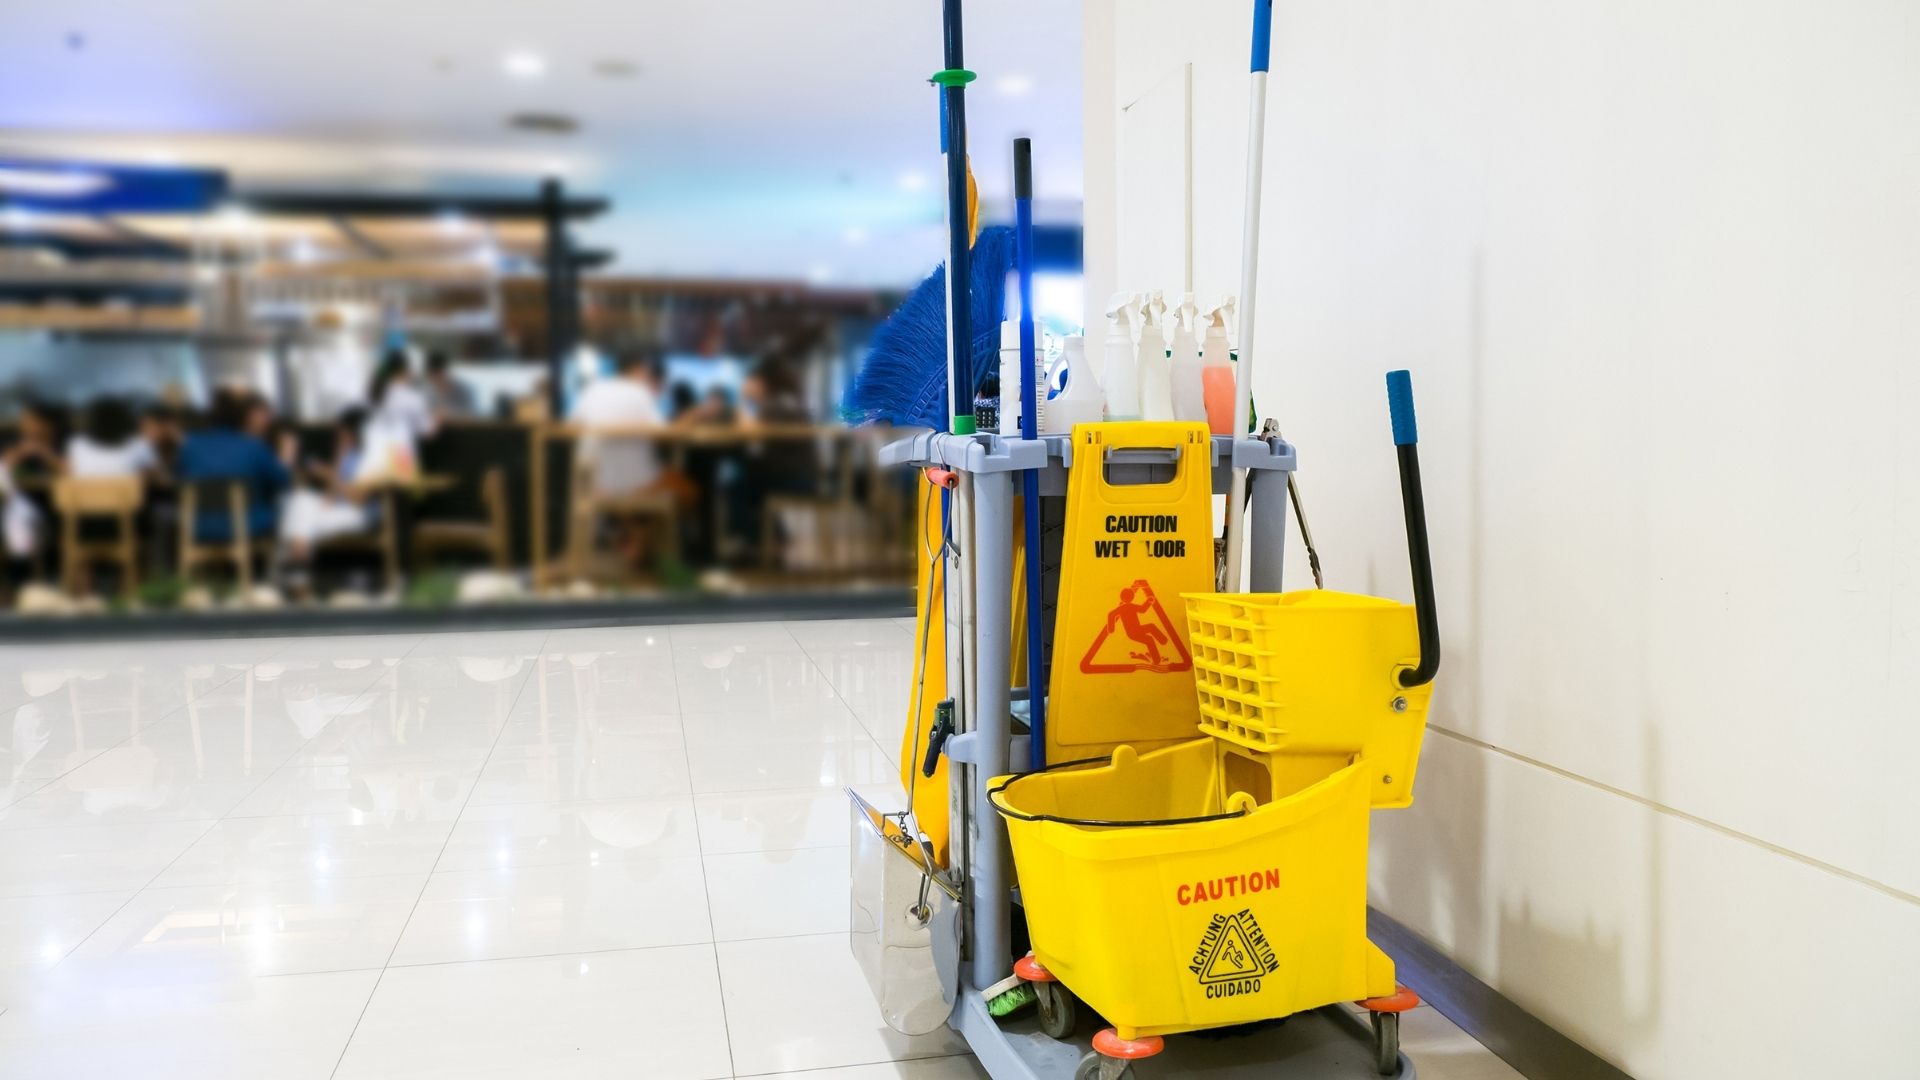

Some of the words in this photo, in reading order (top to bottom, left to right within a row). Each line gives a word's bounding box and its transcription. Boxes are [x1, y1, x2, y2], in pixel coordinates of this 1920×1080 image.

[1105, 514, 1178, 534] CAUTION
[1094, 540, 1132, 558] WET
[1138, 539, 1186, 559] LOOR
[1177, 868, 1280, 906] CAUTION
[1188, 913, 1227, 975] ACHTUNG
[1237, 908, 1280, 973] ATTENTION
[1206, 979, 1261, 999] CUIDADO
